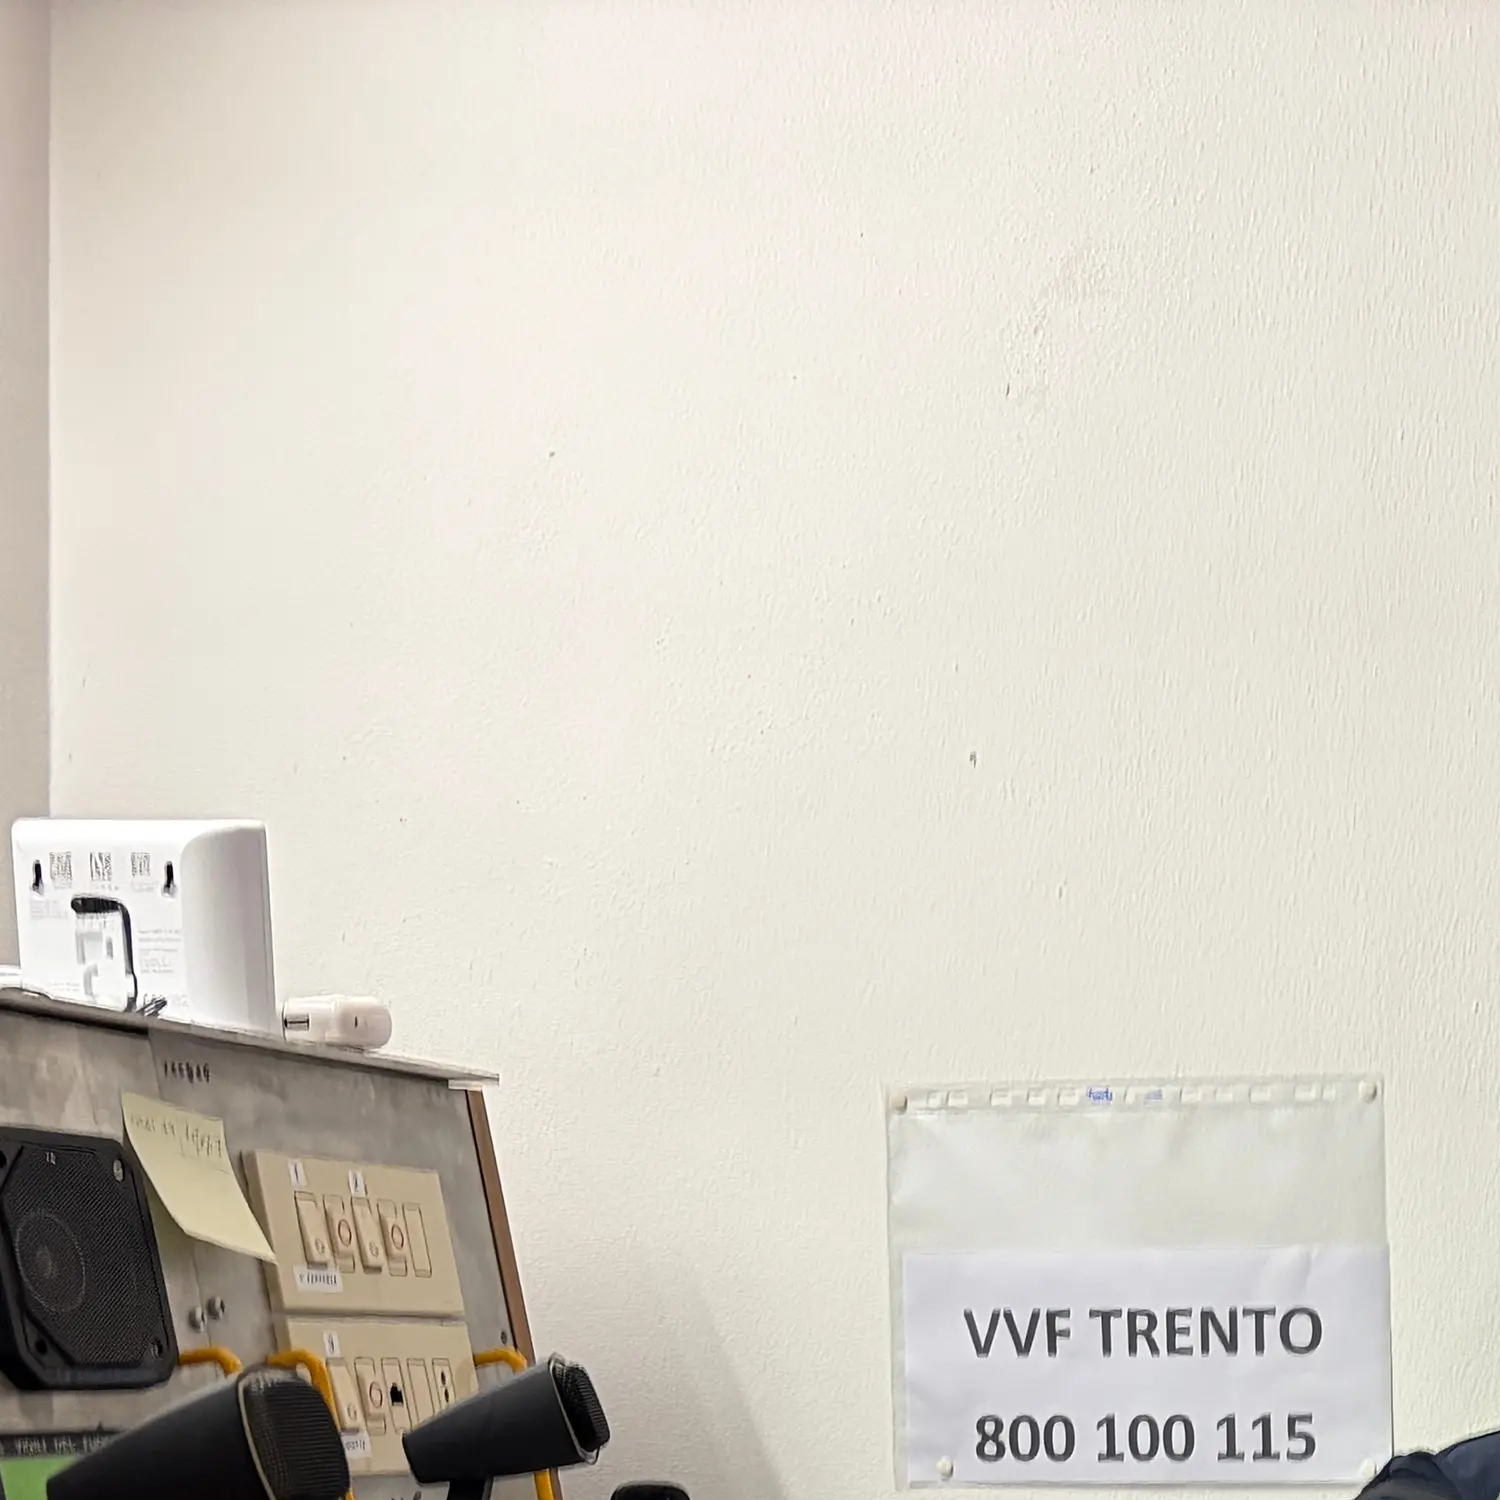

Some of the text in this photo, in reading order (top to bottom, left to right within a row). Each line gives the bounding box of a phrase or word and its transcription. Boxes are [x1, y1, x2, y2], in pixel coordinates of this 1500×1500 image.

[963, 1306, 1322, 1358] VVF TRENTO
[975, 1412, 1317, 1462] 800 100 115
